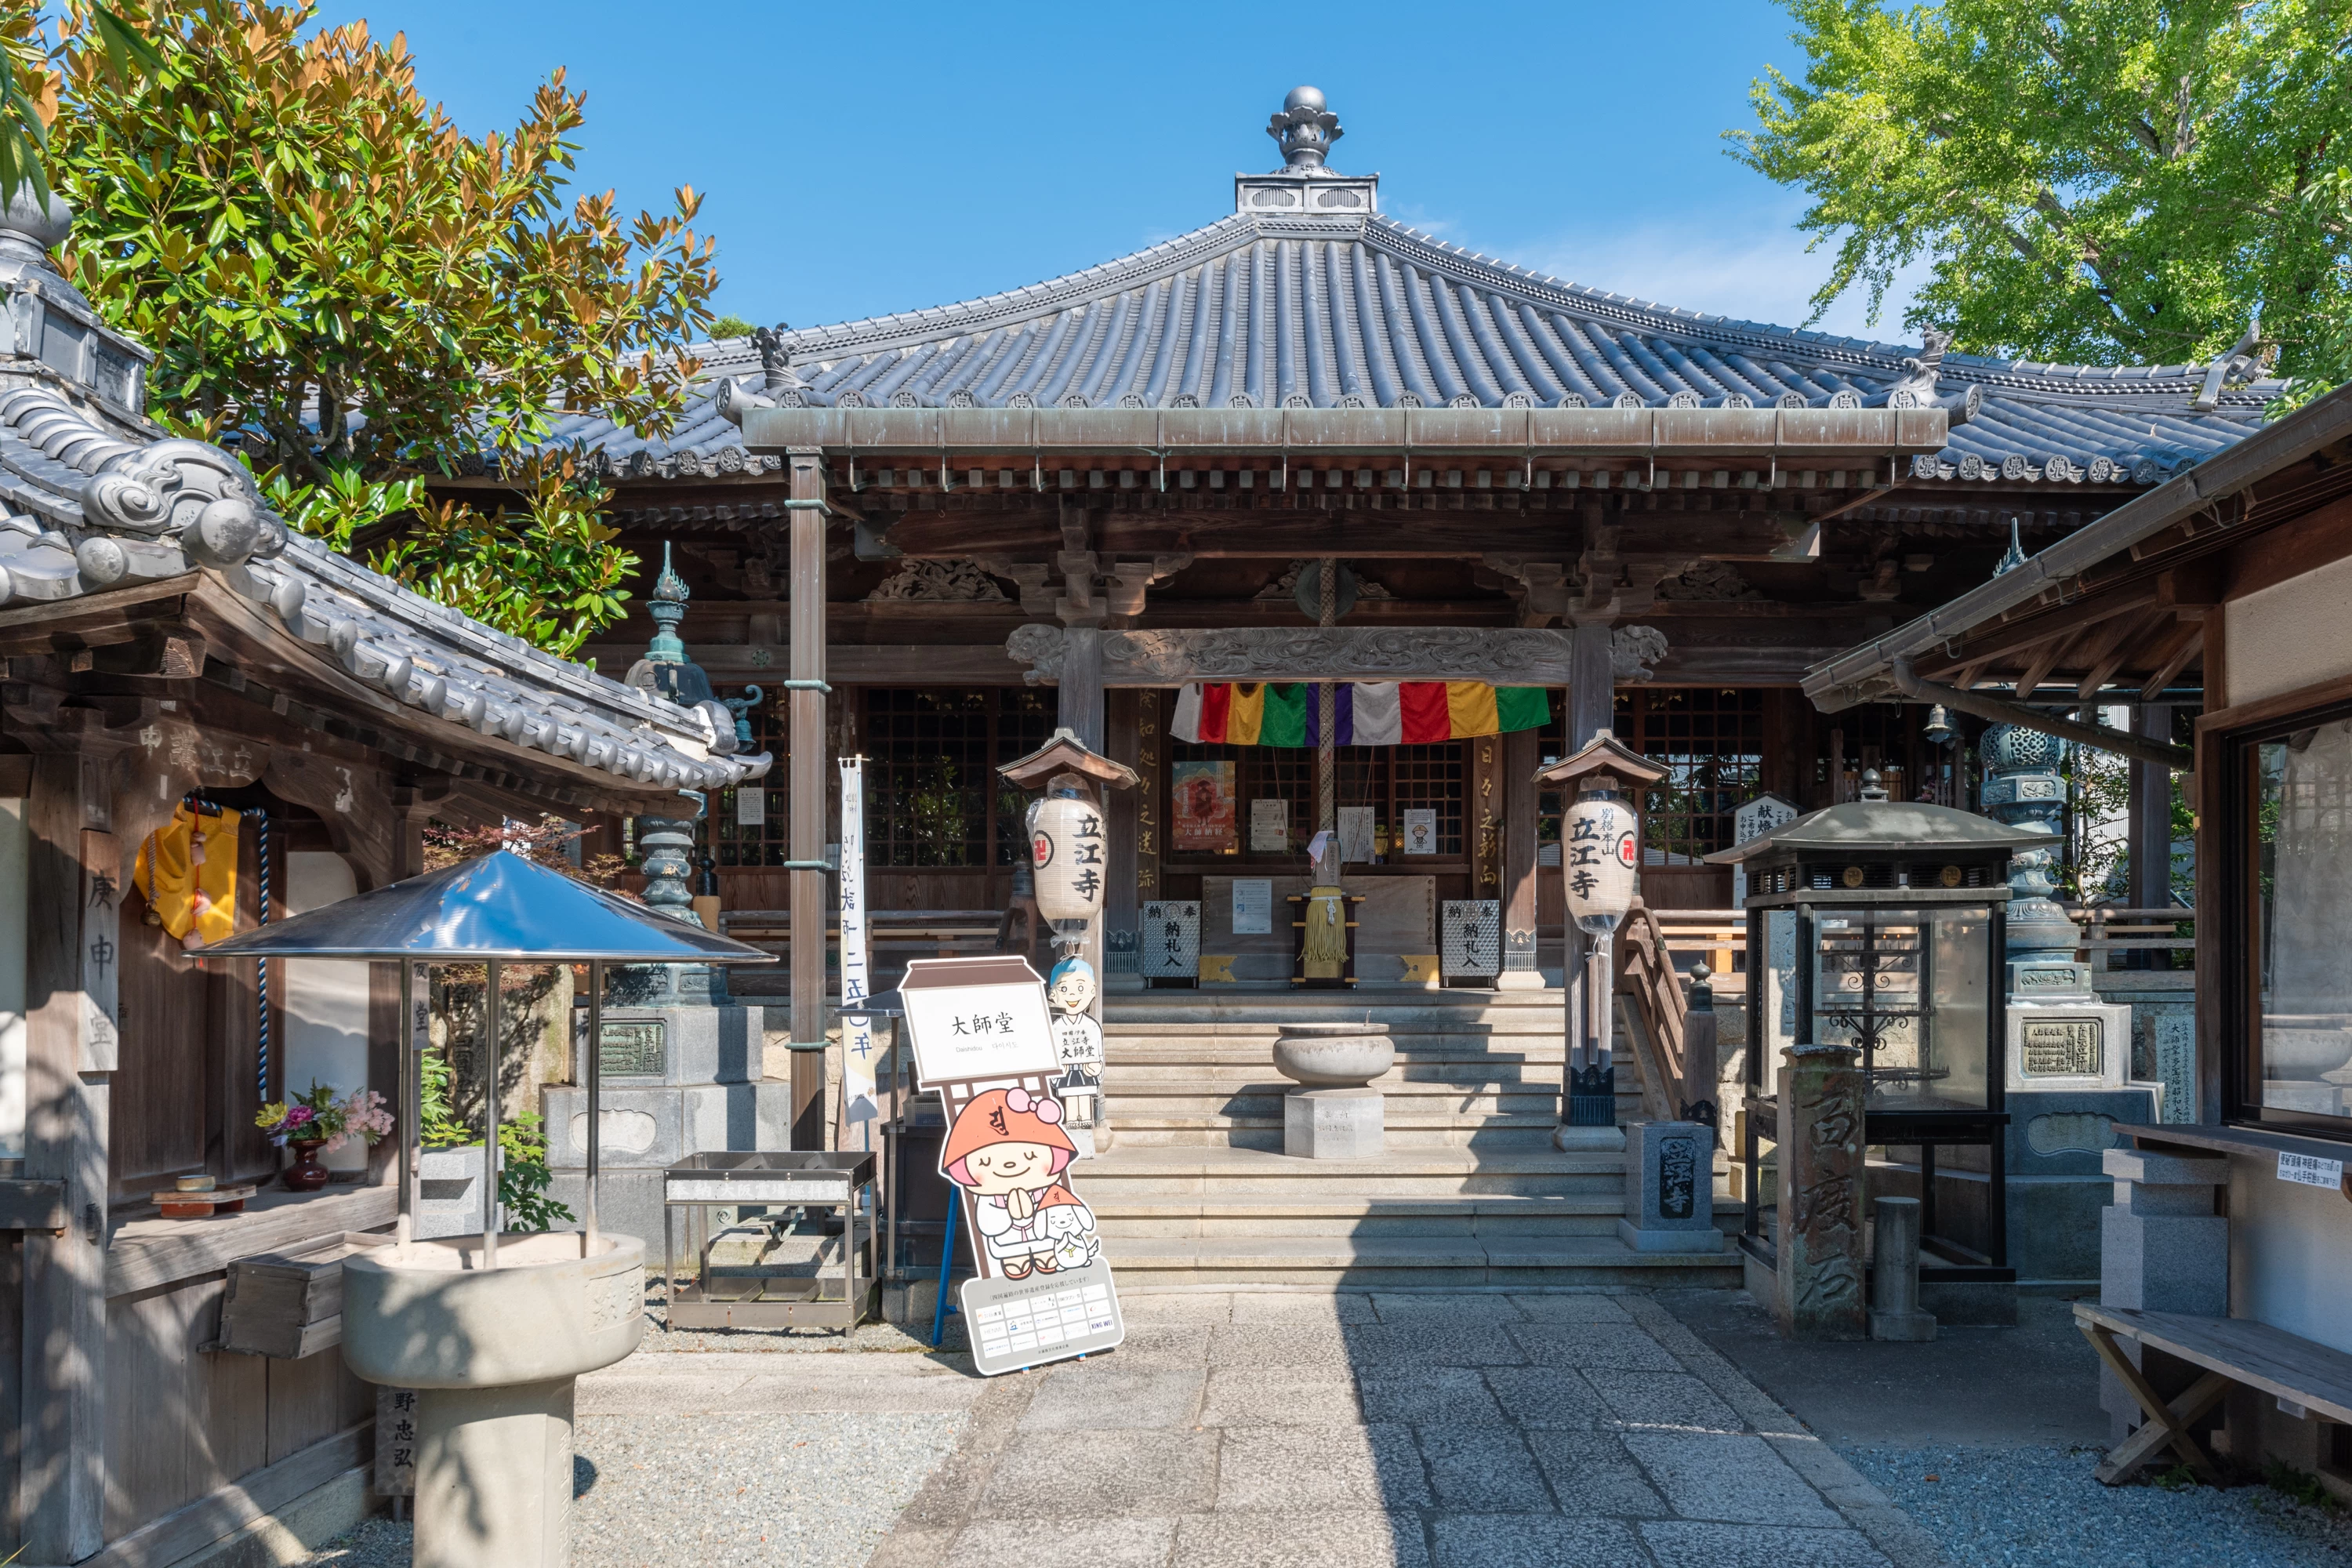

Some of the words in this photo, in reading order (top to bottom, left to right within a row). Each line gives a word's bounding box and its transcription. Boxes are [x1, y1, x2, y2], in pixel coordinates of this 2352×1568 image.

[1071, 813, 1102, 903] 立江寺
[1569, 817, 1601, 901] 立江寺
[87, 869, 117, 1047] 庚申堂
[1163, 921, 1183, 967] 納札入
[1461, 923, 1481, 967] 納札入
[951, 1011, 1015, 1036] 大師堂
[992, 1041, 1019, 1051] 다이시도
[1061, 1036, 1091, 1047] 立江寺
[956, 1045, 983, 1054] Daishidou
[1060, 1045, 1095, 1060] 大師堂
[1663, 1141, 1693, 1214] 立江寺
[1798, 1087, 1860, 1308] 百度石
[394, 1392, 416, 1468] 野忠弘
